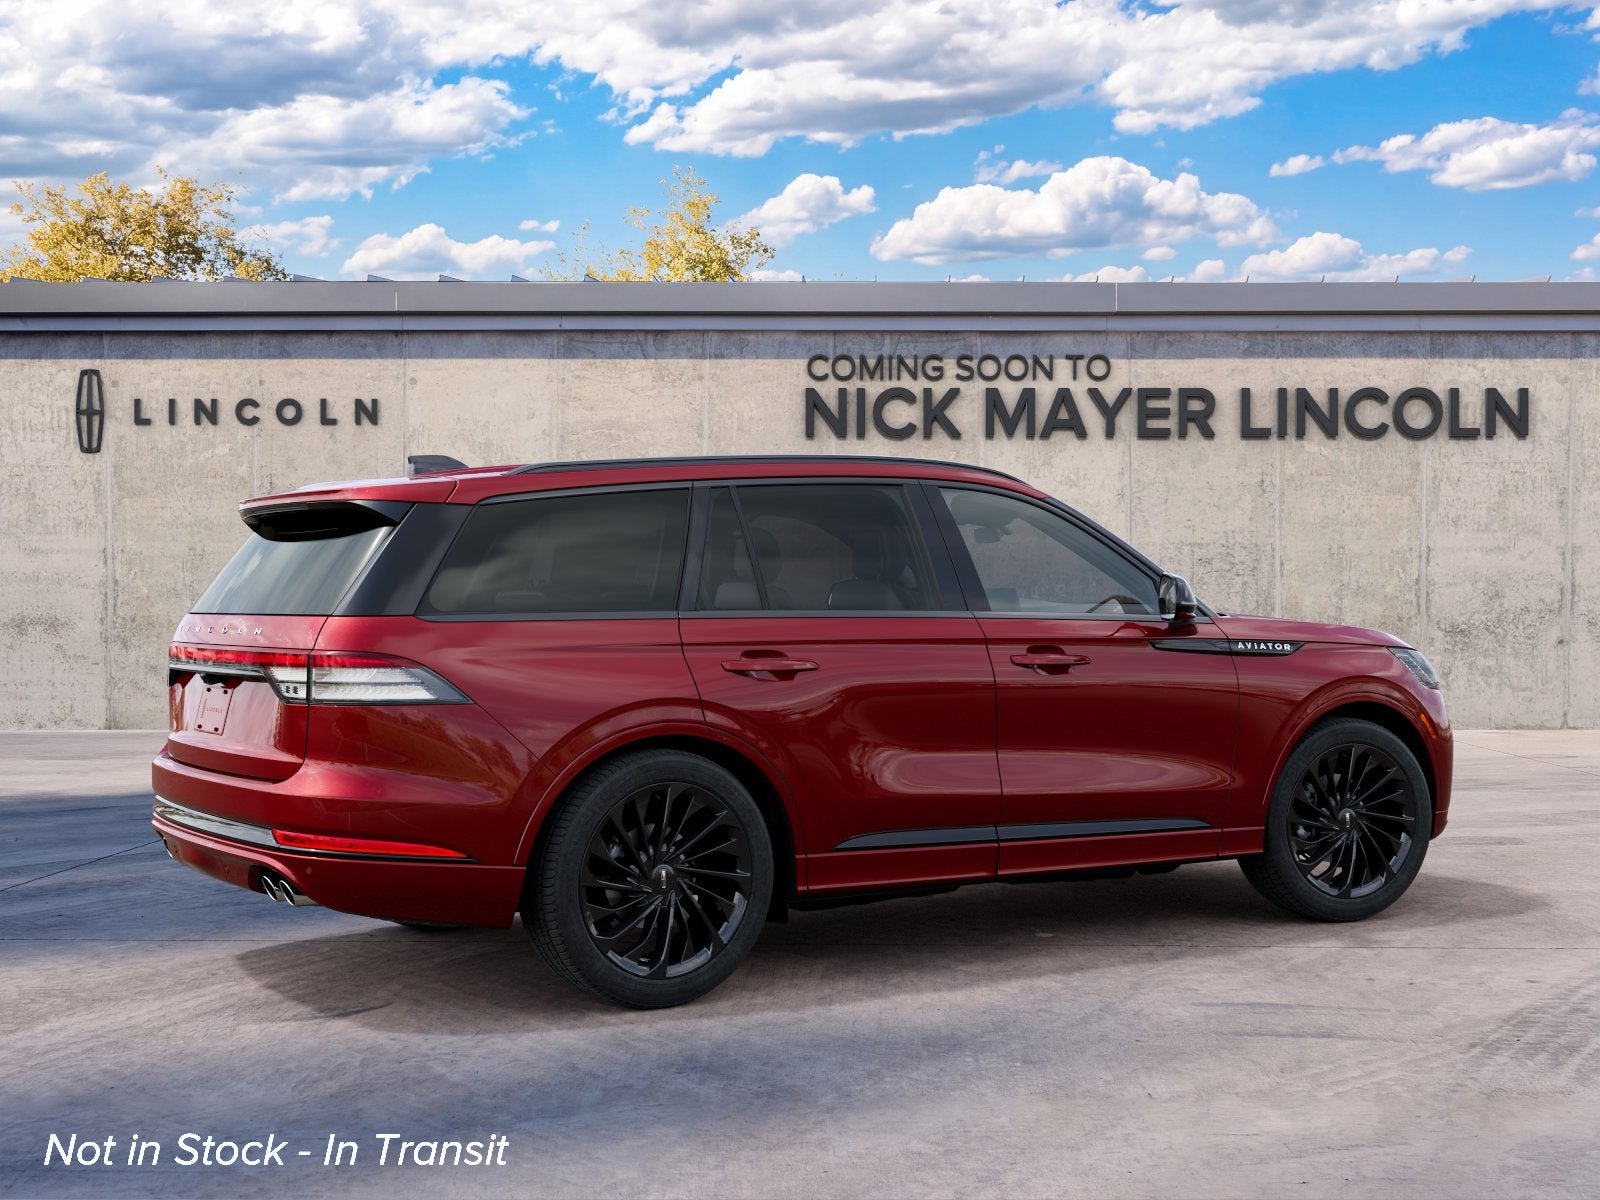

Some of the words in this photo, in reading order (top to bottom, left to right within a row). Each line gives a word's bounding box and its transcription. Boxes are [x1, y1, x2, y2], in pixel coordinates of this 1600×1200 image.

[806, 353, 946, 382] COMING
[954, 353, 1055, 382] SOON
[1064, 353, 1112, 382] TO
[133, 397, 379, 427] LINCOLN
[804, 386, 962, 442] NICK
[984, 386, 1217, 442] MAYER
[1239, 386, 1530, 442] LINCOLN
[1237, 641, 1291, 651] AVIATOR
